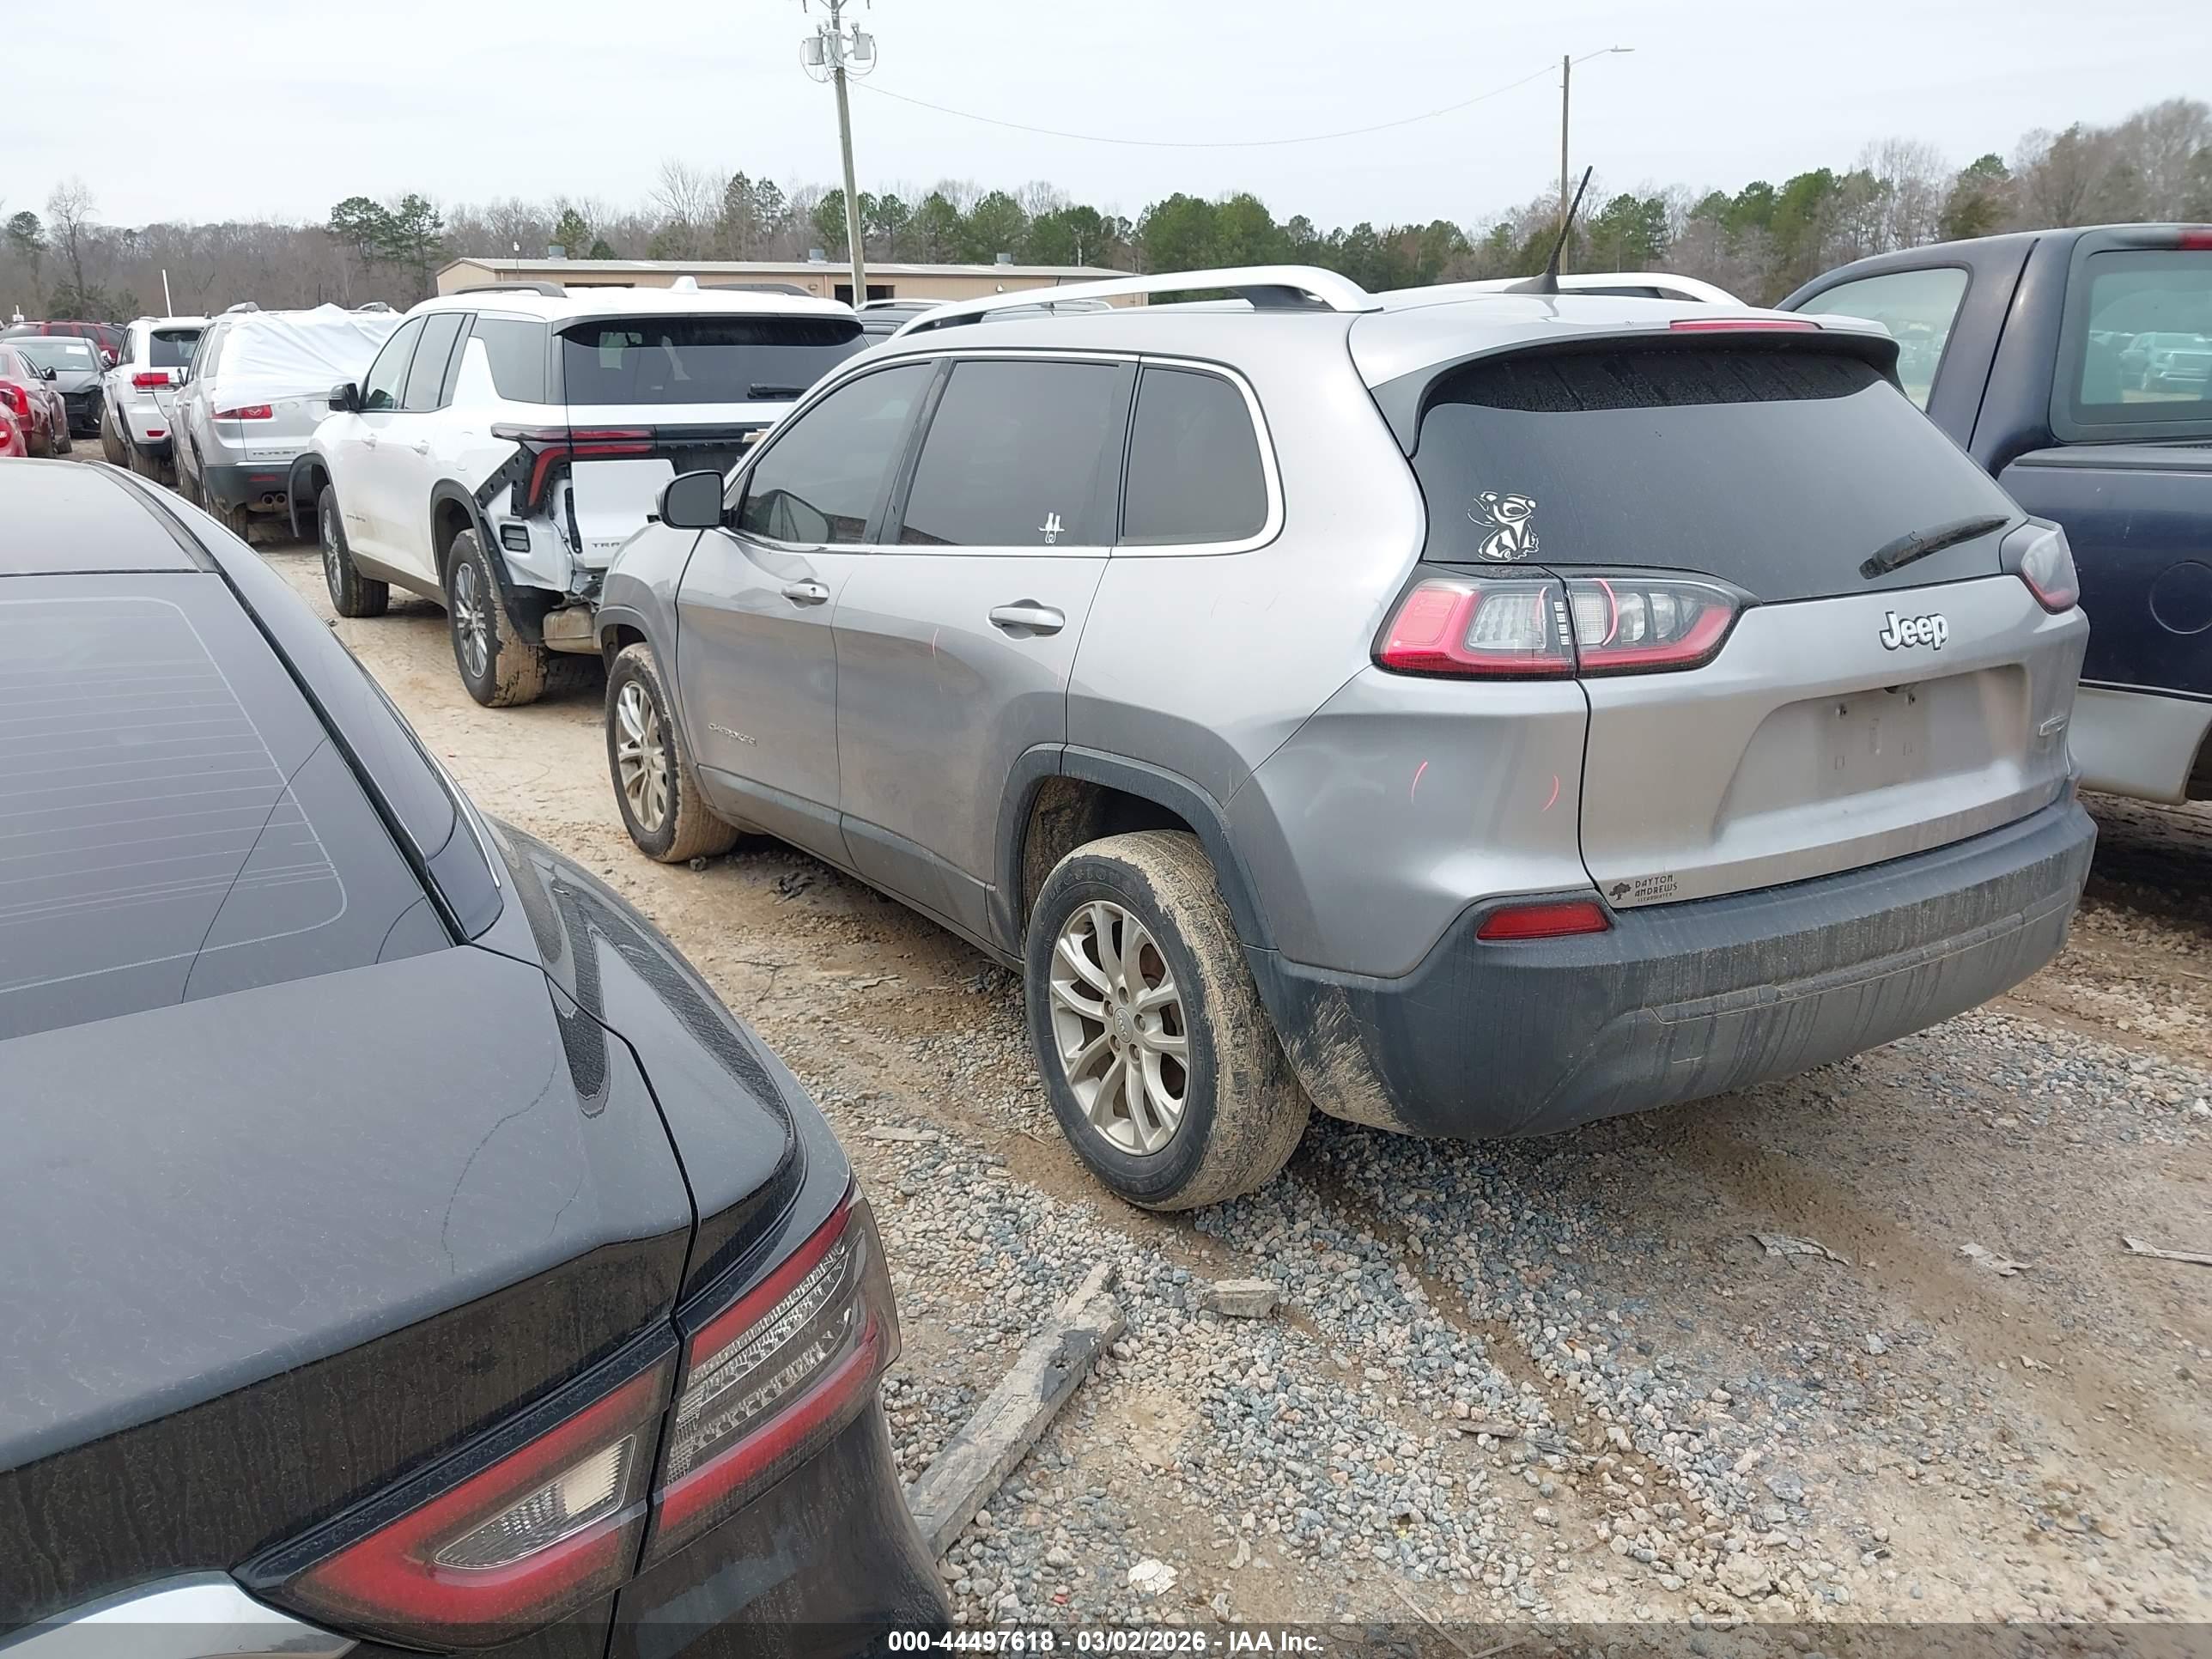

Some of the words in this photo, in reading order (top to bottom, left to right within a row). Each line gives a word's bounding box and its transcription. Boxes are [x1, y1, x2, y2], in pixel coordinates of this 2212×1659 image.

[1879, 611, 1948, 651] Jeep
[1635, 874, 1673, 888] DAYTON
[1634, 882, 1677, 896] ANDREWS
